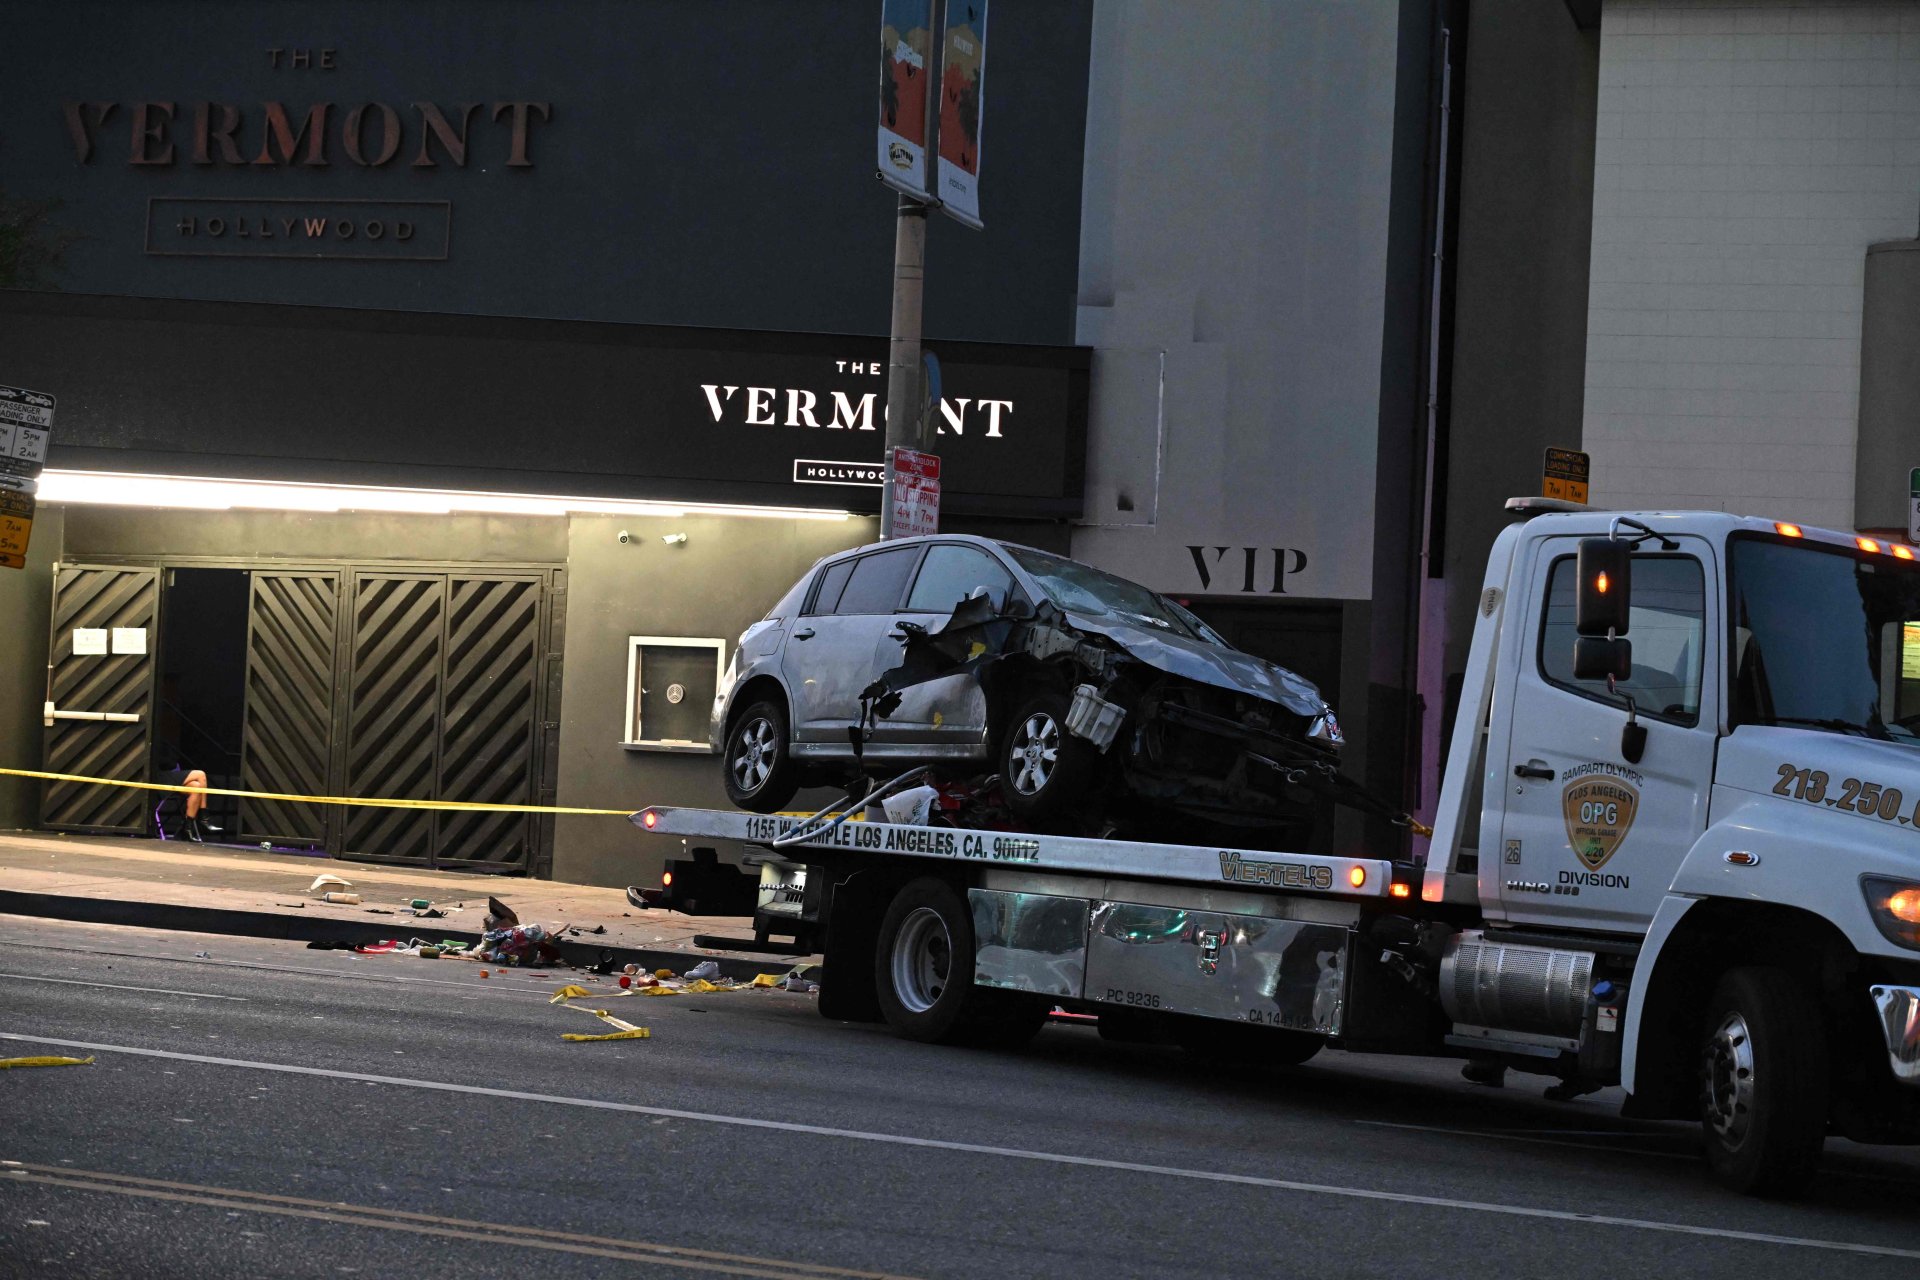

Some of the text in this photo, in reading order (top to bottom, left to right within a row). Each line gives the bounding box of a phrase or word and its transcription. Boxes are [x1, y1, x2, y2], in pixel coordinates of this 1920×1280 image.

[265, 48, 337, 70] THE
[60, 99, 554, 169] VERMONT
[176, 215, 416, 241] HOLLYWOOD
[835, 360, 881, 376] THE
[26, 414, 47, 424] ONLY
[700, 383, 1014, 438] VERMNT
[23, 429, 41, 441] 5PM
[806, 466, 885, 481] HOLLYWOO
[895, 484, 938, 507] NO STOPPING
[897, 505, 910, 519] 4PM
[920, 509, 934, 523] 7PM
[1185, 545, 1308, 593] VIP
[1561, 762, 1644, 788] RAMPART OLYMPIC
[1574, 785, 1628, 803] LOS ANGELES
[1580, 800, 1618, 826] OPG
[745, 817, 776, 839] 1155
[854, 825, 881, 849] LOS
[886, 828, 958, 859] ANGELES,
[963, 835, 989, 858] CA.
[1506, 846, 1519, 862] 26
[1219, 851, 1333, 889] VIERTEL'S
[1559, 870, 1630, 889] DIVISION
[1106, 988, 1160, 1008] PC 9236
[1249, 1008, 1263, 1023] CA
